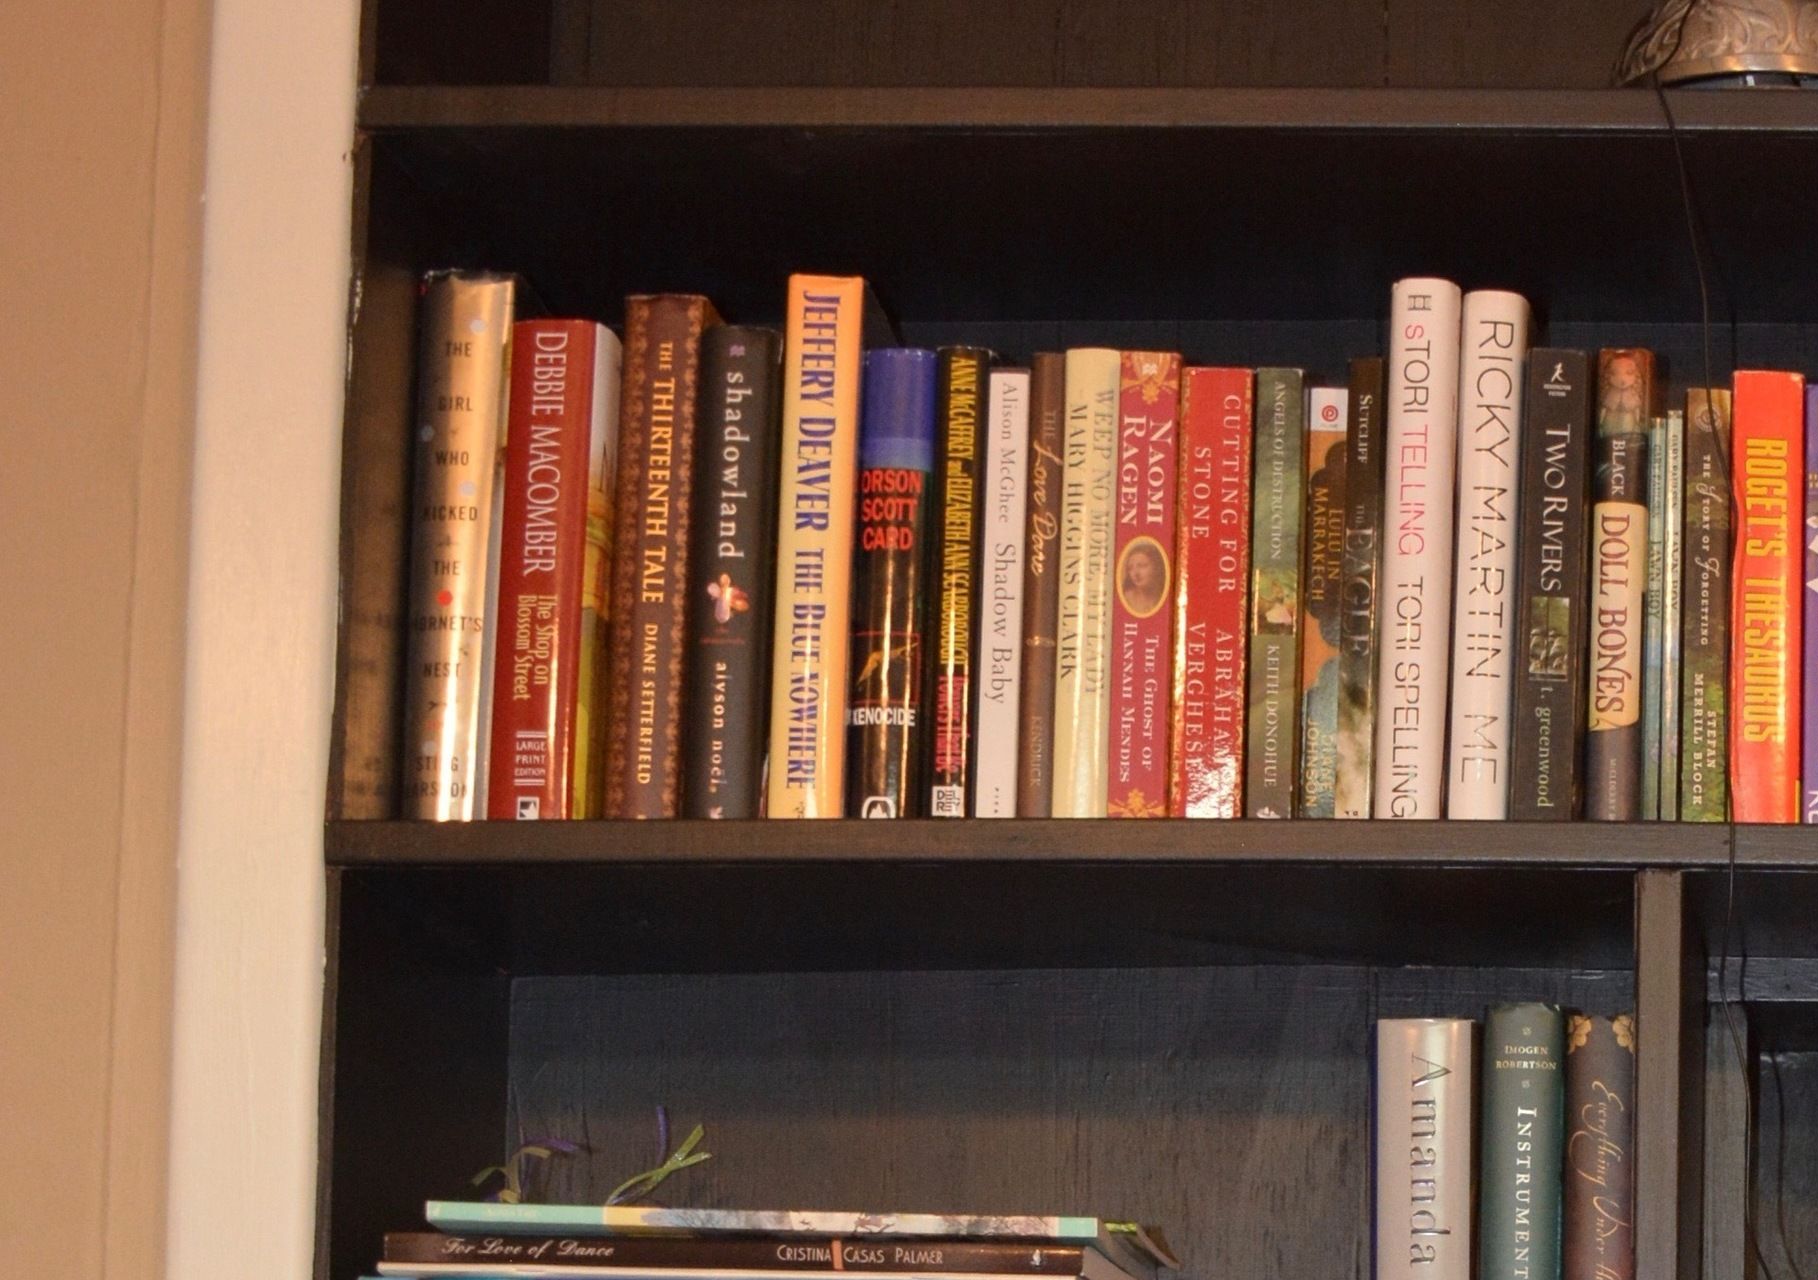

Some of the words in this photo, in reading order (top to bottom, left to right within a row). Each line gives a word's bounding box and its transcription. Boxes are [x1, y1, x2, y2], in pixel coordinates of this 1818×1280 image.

[532, 331, 568, 415] DEBBIE
[657, 342, 673, 370] THE
[799, 291, 840, 411] JEFFERY
[1475, 320, 1516, 468] RICKY
[644, 378, 674, 552] THIRTEENTH
[718, 372, 752, 558] shadowland
[795, 416, 837, 531] DEAVER
[862, 473, 921, 493] ORSON
[1544, 424, 1572, 488] TWO
[1745, 438, 1789, 558] ROGET'S
[523, 424, 563, 576] MACOMBER
[862, 500, 917, 521] SCOTT
[863, 529, 913, 550] CARD
[642, 557, 665, 603] TALE
[795, 550, 824, 594] THE
[1464, 486, 1508, 678] MARTIN
[1539, 497, 1567, 592] RIVERS
[1600, 515, 1631, 598] DOLL
[791, 606, 827, 663] BLUE
[1594, 607, 1629, 715] BONES
[1744, 577, 1788, 744] THESAURUS
[786, 666, 821, 790] NOWHERE
[1461, 715, 1498, 783] ME
[1496, 1059, 1556, 1071] ROBERTSON
[1505, 1045, 1549, 1056] IMOGEN
[1409, 1054, 1451, 1265] Amanda
[777, 1245, 832, 1263] CRISTINA
[844, 1247, 884, 1265] CASAS
[895, 1248, 942, 1265] PALMER
